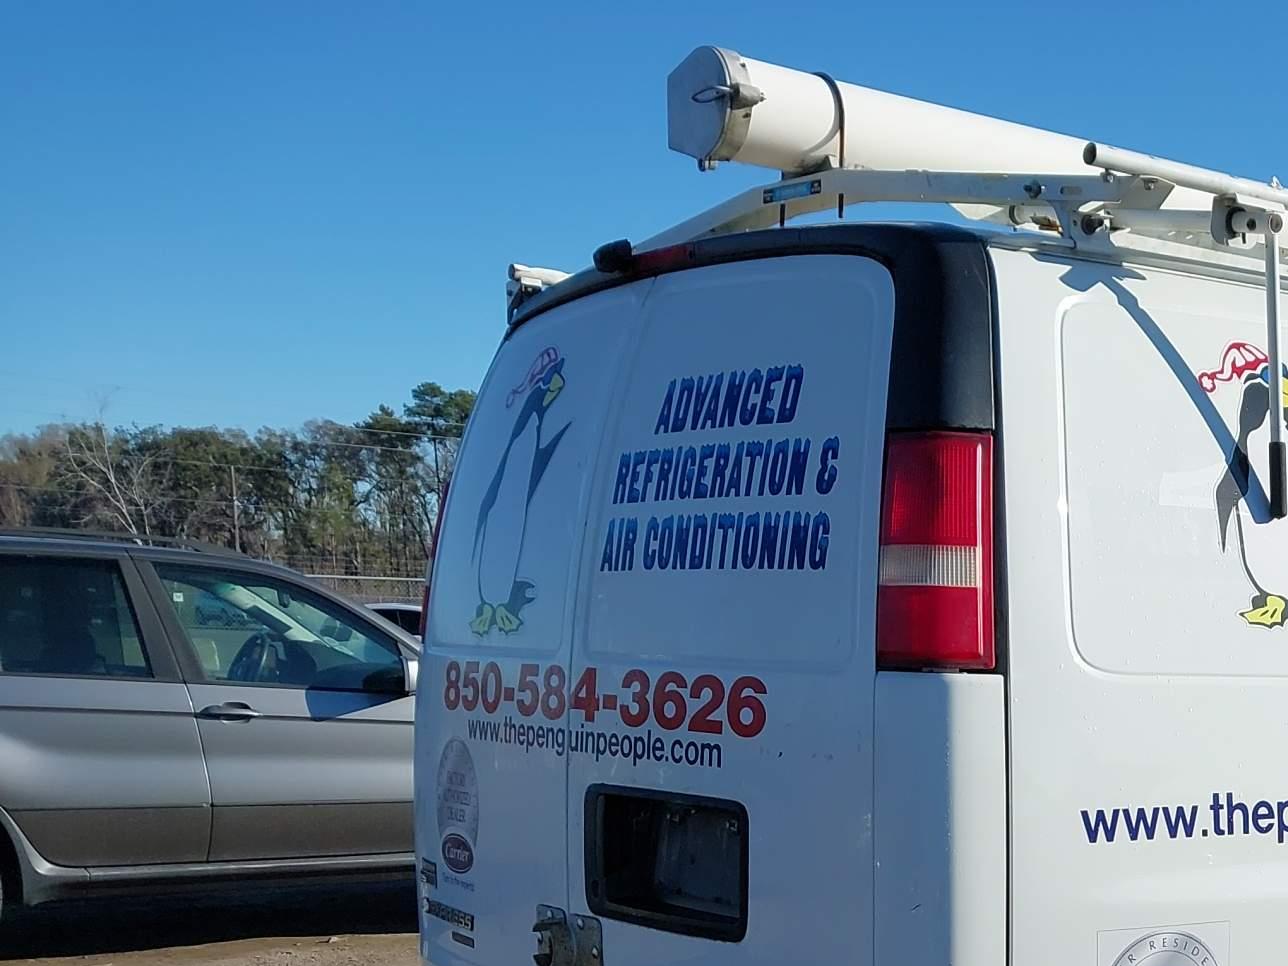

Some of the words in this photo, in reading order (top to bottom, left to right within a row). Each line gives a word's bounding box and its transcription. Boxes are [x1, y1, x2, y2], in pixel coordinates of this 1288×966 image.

[654, 363, 804, 435] ADVANCED
[612, 439, 810, 504] REFRIGERATION
[816, 436, 839, 495] &
[600, 517, 635, 572] AIR
[642, 510, 831, 571] CONDITIONING
[444, 660, 768, 738] 850-584-3626
[467, 716, 723, 768] www.thepenguinpeople.com
